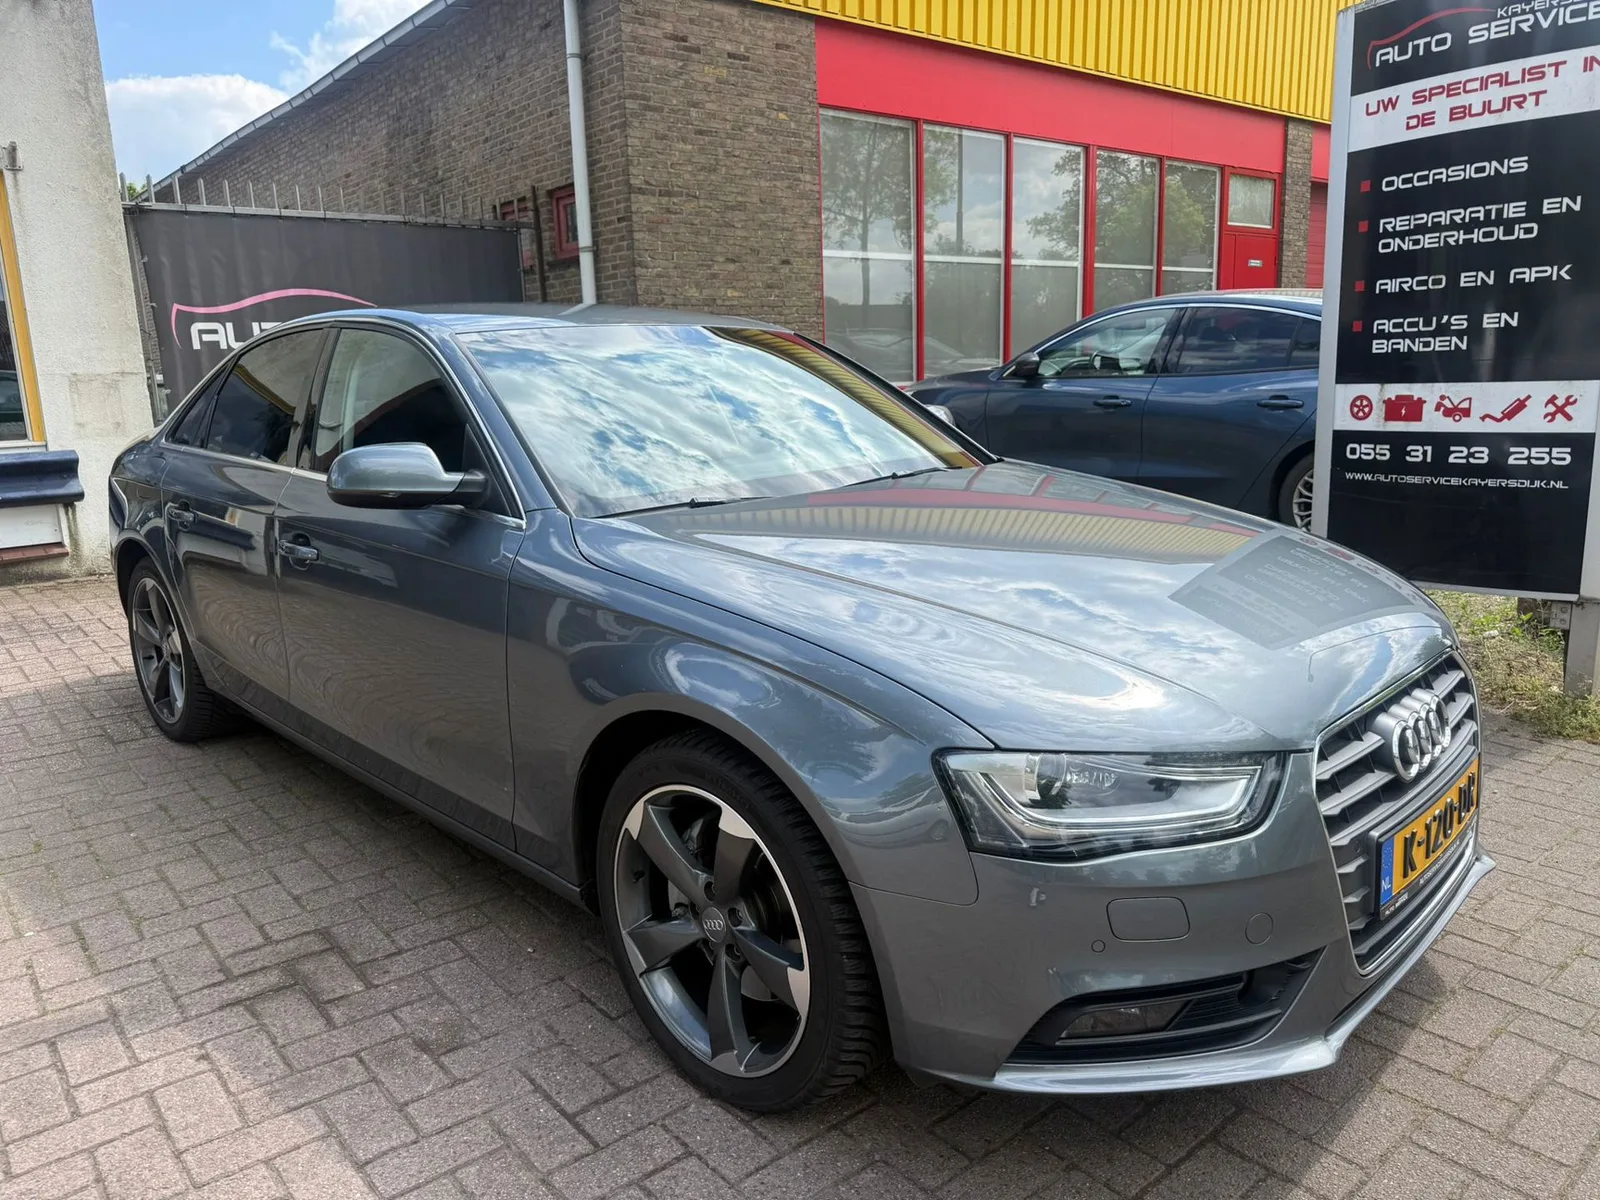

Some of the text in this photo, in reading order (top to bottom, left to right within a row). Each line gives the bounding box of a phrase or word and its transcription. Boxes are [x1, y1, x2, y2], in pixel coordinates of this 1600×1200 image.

[1497, 0, 1587, 18] KAYER
[1375, 0, 1600, 67] AUTO SERVICE
[1365, 95, 1400, 116] UW
[1411, 60, 1567, 106] SPECIALIST
[1405, 89, 1548, 131] DE BUURT
[1381, 156, 1528, 192] OCCASIONS
[1379, 195, 1582, 233] REPARATIE EN
[1378, 222, 1539, 254] ONDERHOUD
[1375, 264, 1573, 294] AIRCO EN APK
[190, 321, 283, 350] AU
[1373, 312, 1519, 334] ACCU'S EN
[1371, 336, 1468, 354] BANDEN
[1345, 443, 1572, 466] 055 31 23 255
[1345, 471, 1570, 490] WWW.AUTOSERVICEKAYERSDIJK.NL
